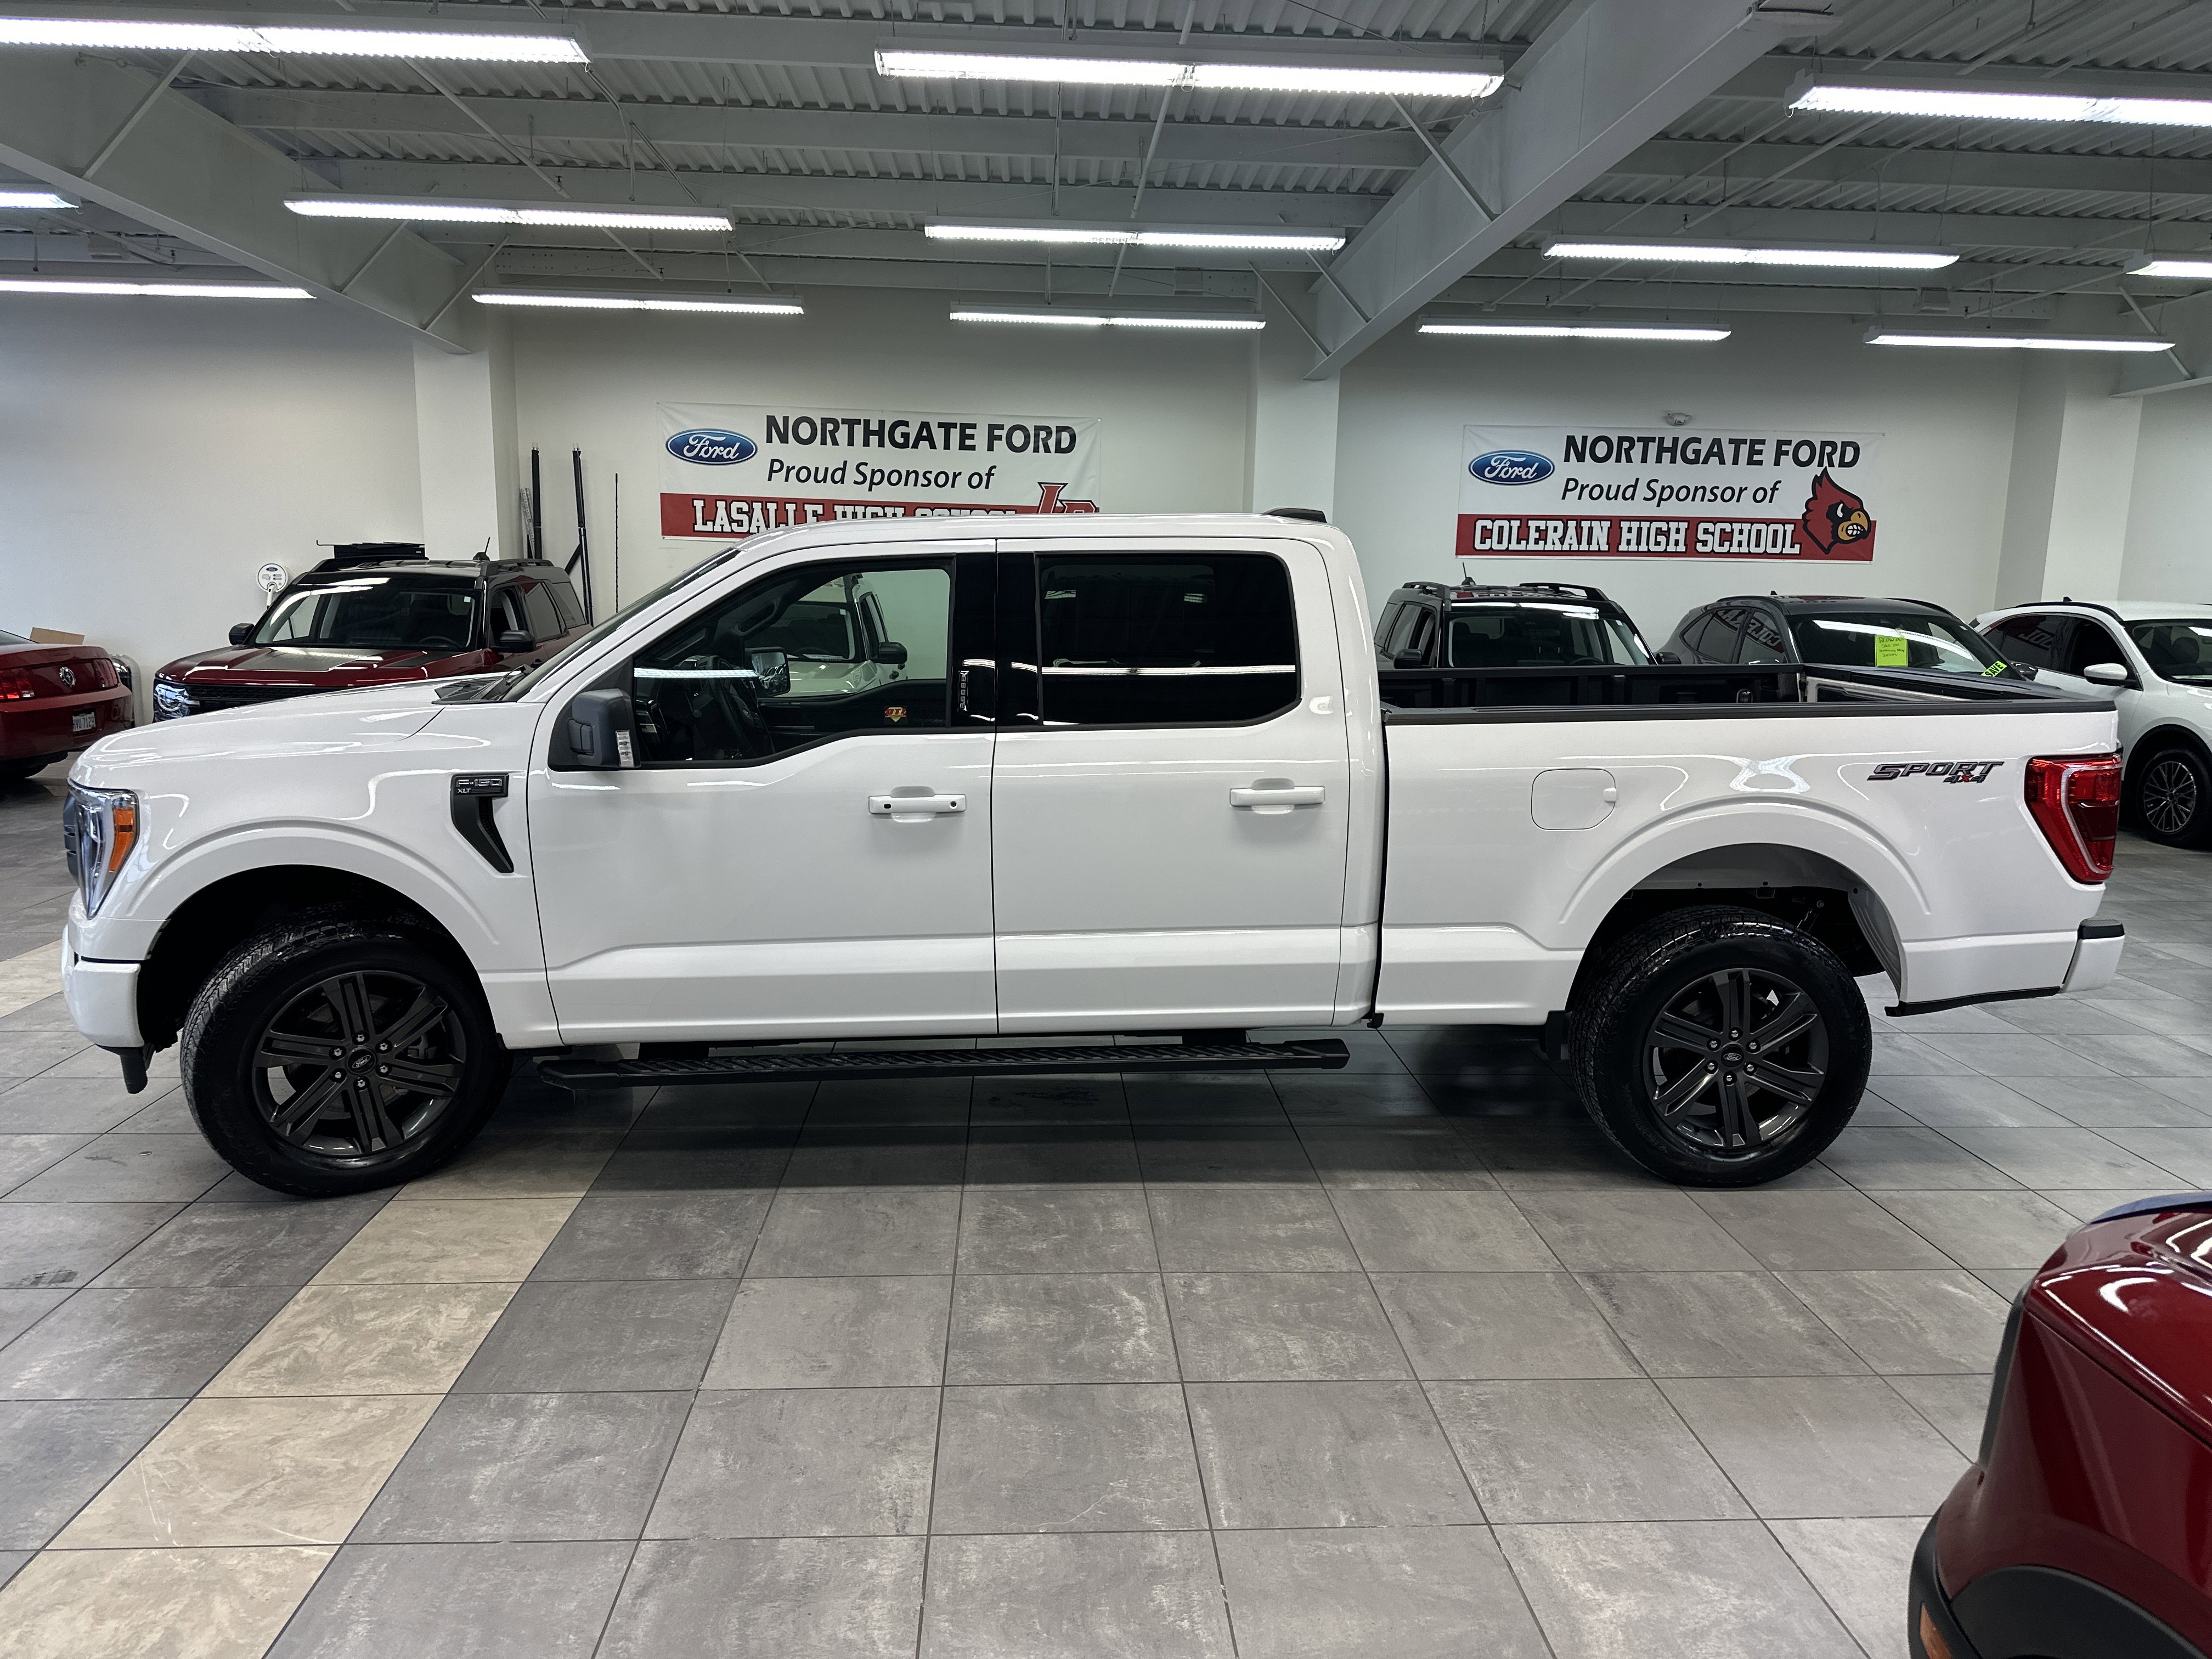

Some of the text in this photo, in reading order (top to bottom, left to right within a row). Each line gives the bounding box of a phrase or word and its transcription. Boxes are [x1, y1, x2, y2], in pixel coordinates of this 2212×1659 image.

[684, 434, 741, 459] Ford
[766, 415, 1077, 454] NORTHGATE FORD
[1564, 435, 1860, 468] NORTHGATE FORD
[767, 459, 997, 492] Proud Sponsor of
[1485, 455, 1539, 479] Ford
[1561, 477, 1782, 507] Proud Sponsor of
[1474, 518, 1802, 555] COLERAIN HIGH SCHOOL
[1985, 662, 2004, 677] SAVE
[456, 778, 503, 788] F-150
[1867, 761, 2005, 781] SPORT
